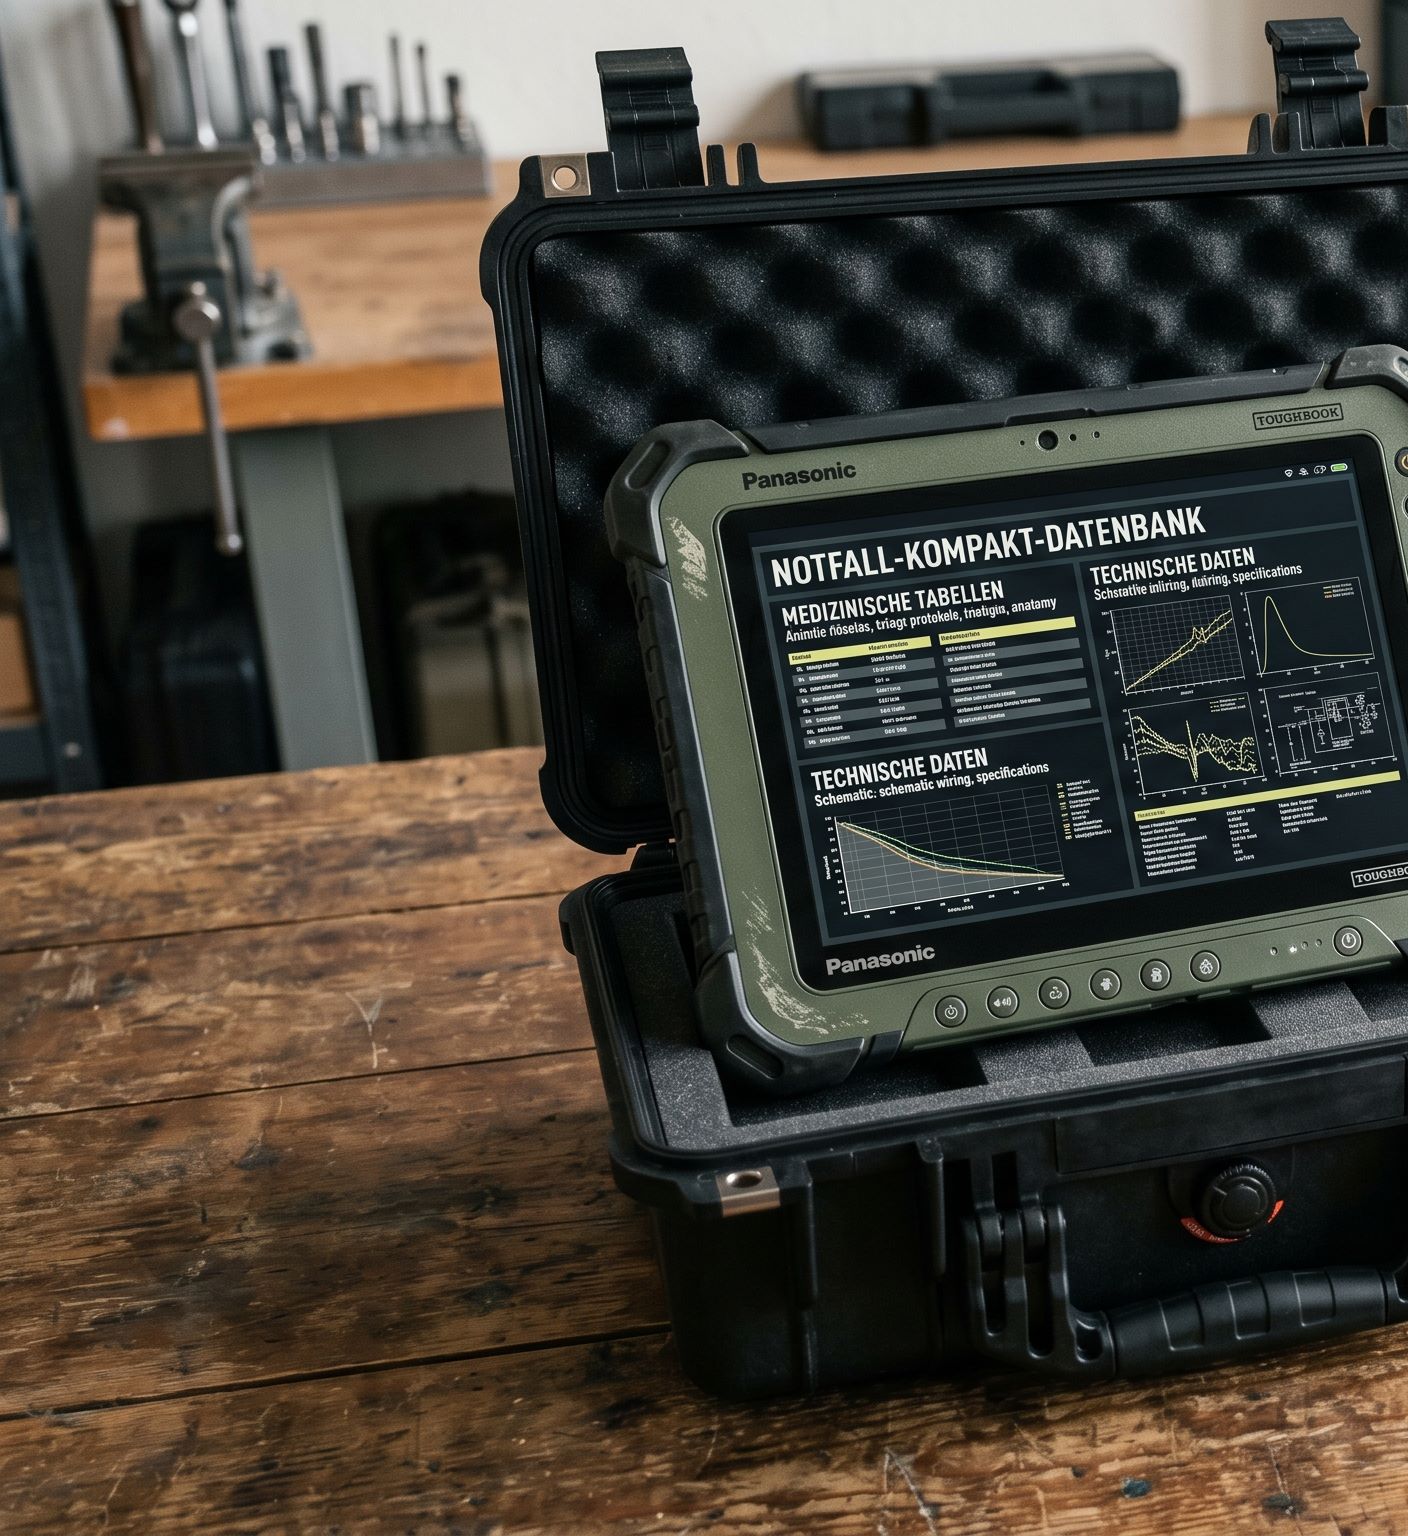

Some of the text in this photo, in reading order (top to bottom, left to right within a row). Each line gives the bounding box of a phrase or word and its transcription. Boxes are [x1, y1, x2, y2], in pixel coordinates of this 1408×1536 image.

[1257, 407, 1339, 426] TOUGHBOOK
[742, 461, 856, 490] Panasonic
[771, 506, 1206, 587] NOTFALL-KOMPAKT-DATENBANK
[1089, 546, 1256, 586] TECHNISCHE DATEN
[1233, 564, 1302, 585] specifications
[782, 580, 1004, 626] MEDIZINISCHE TABELLEN
[810, 747, 988, 791] TECHNISCHE DATEN
[814, 762, 1050, 807] Schematic: schematic wiring, specifications
[825, 944, 936, 975] Panasonic
